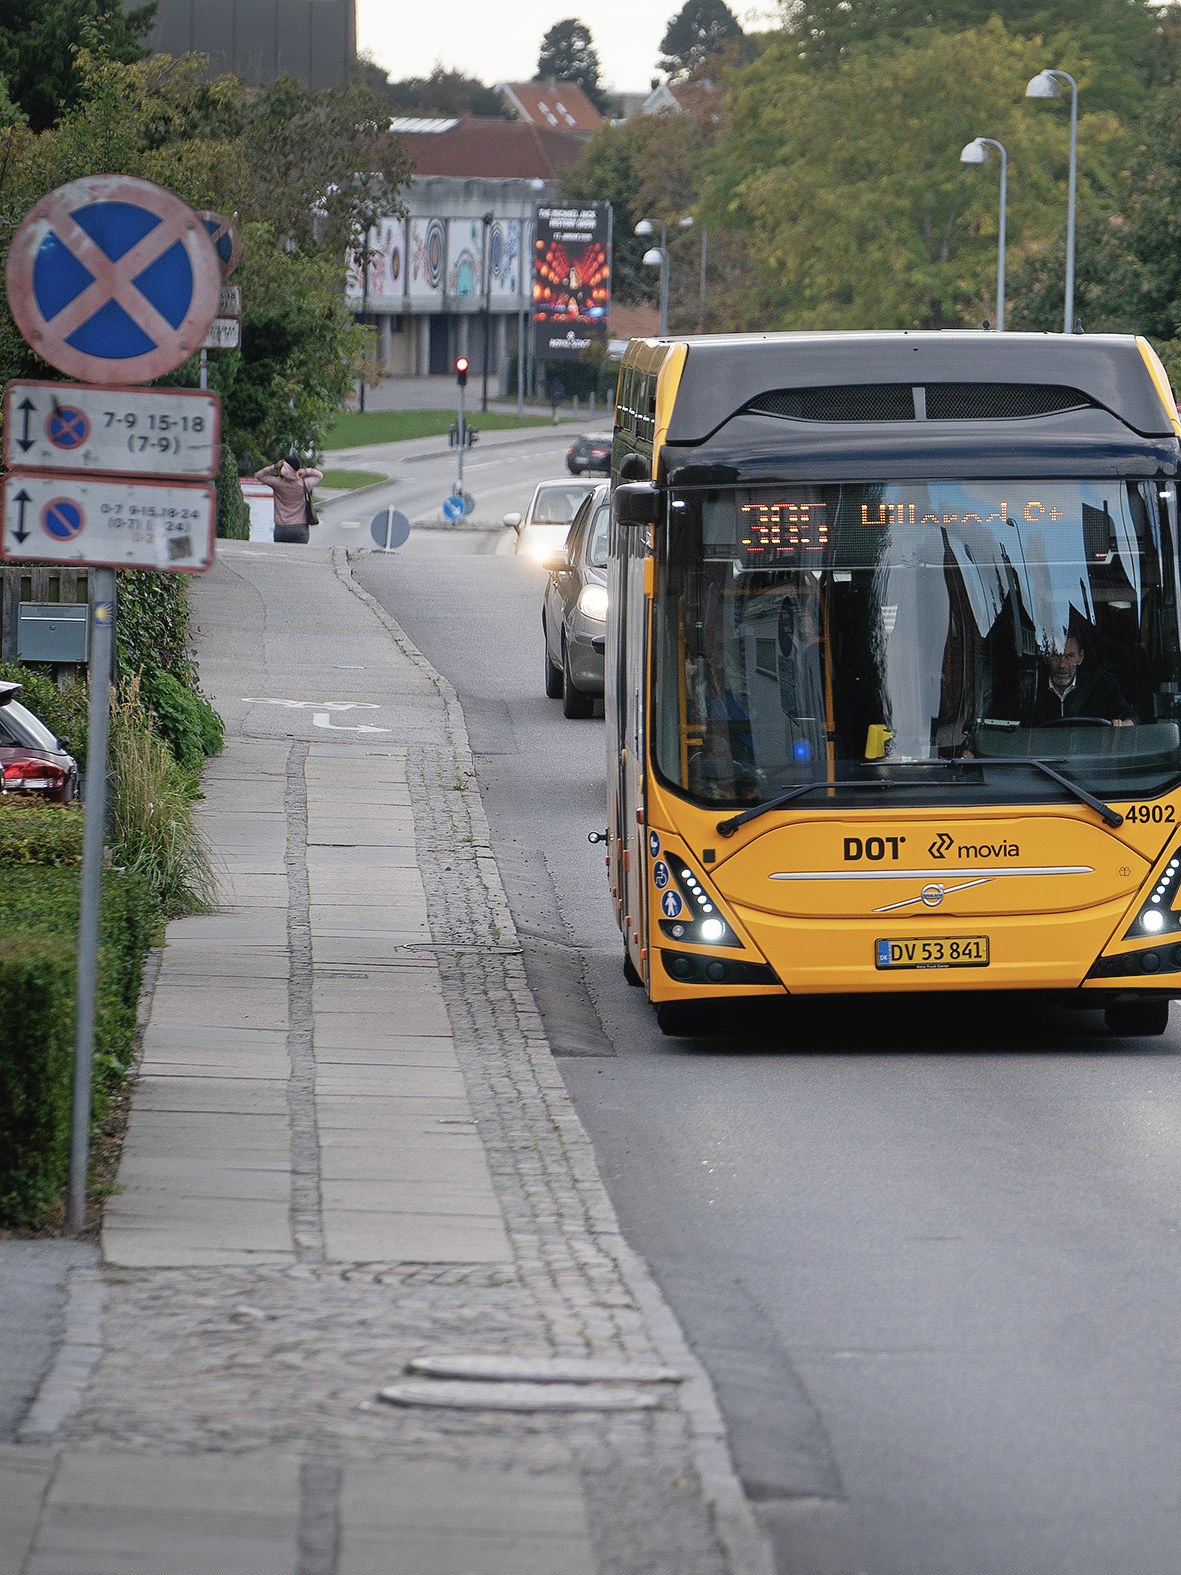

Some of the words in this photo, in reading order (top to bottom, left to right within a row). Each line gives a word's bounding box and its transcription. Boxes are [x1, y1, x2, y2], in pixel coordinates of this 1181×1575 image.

[103, 411, 138, 429] 7-9
[148, 414, 205, 432] 15-18
[127, 433, 181, 455] (7-9)
[1125, 805, 1176, 823] 4902
[843, 836, 906, 861] DOT
[957, 839, 1020, 859] movia
[891, 943, 917, 961] DV
[921, 942, 945, 961] 53
[949, 941, 983, 959] 841
